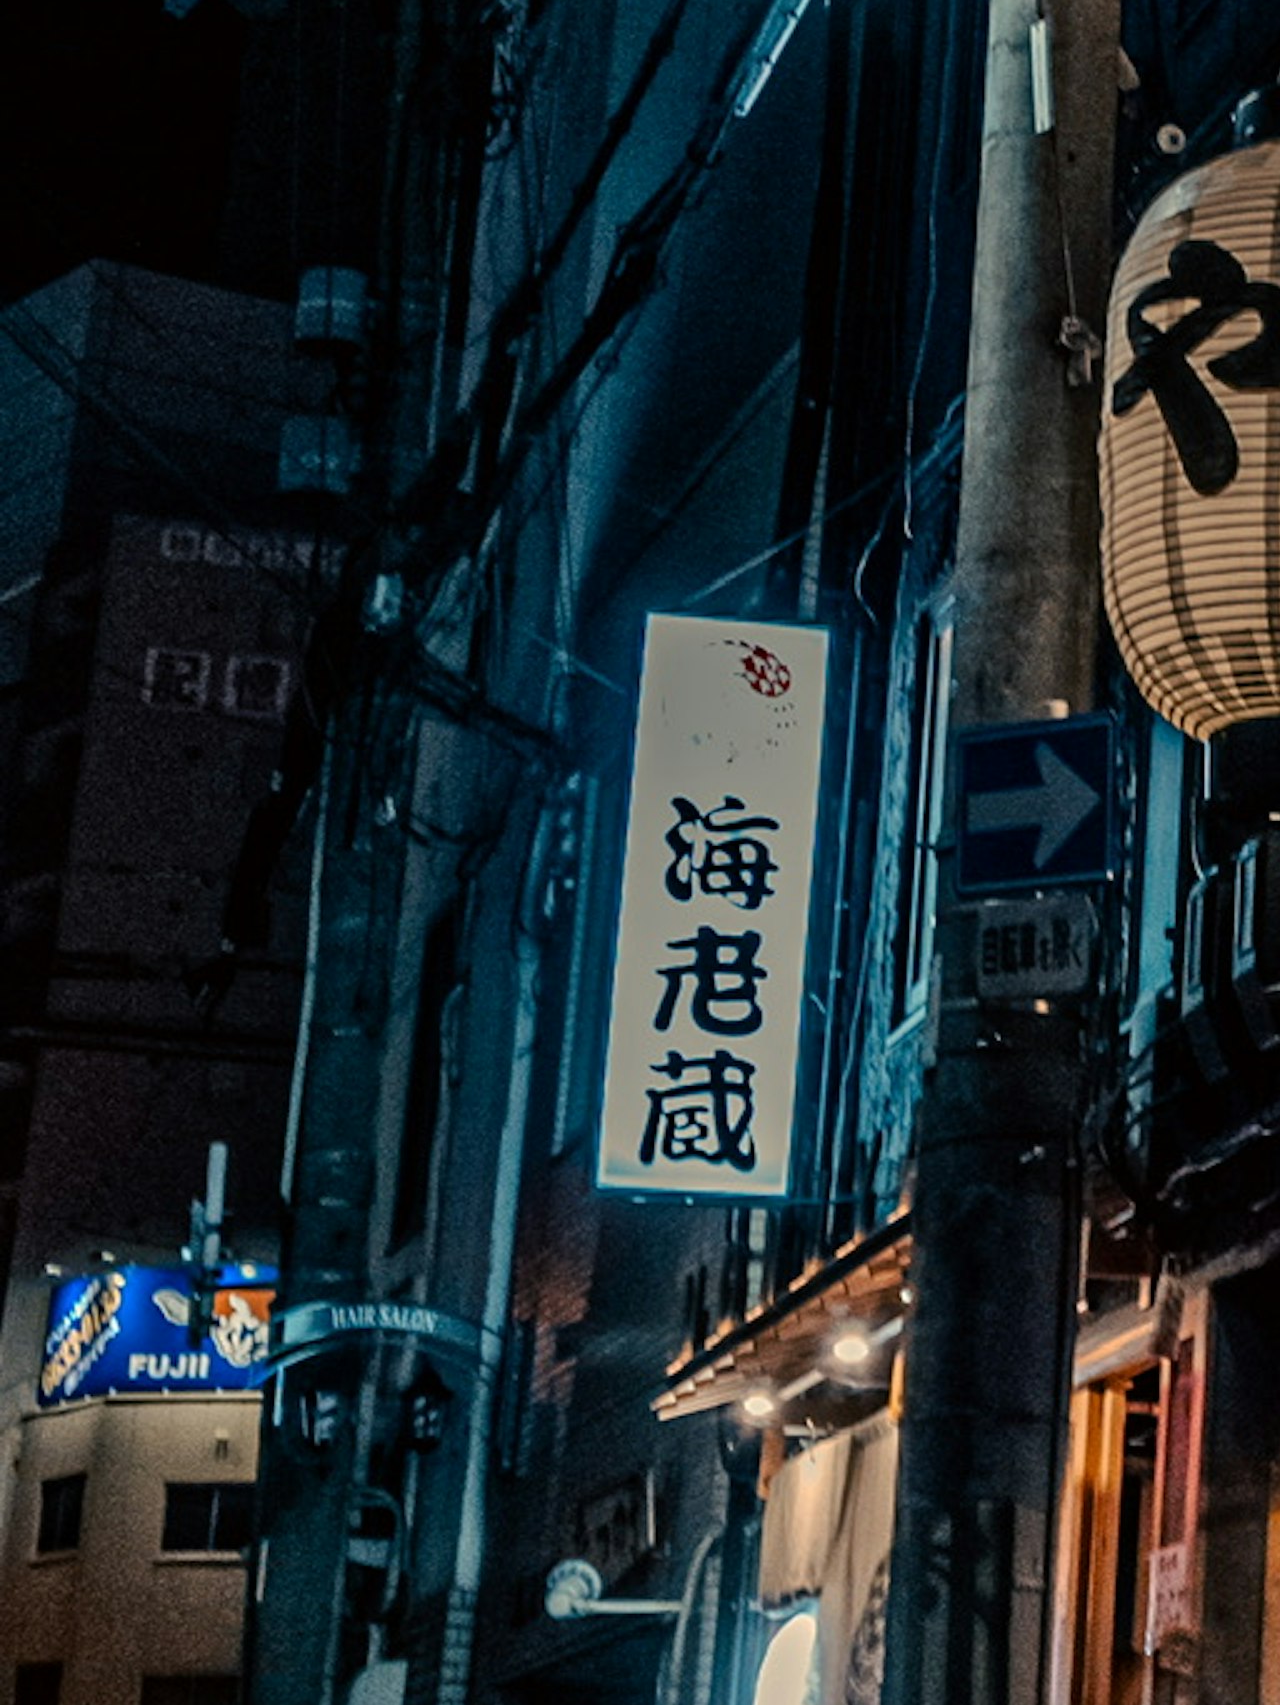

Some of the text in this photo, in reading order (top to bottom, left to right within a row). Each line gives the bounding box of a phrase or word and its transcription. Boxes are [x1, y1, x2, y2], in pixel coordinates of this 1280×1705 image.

[640, 796, 780, 1174] 海老蔵
[330, 1301, 439, 1335] HAIR SALON
[128, 1353, 210, 1380] FUJII
